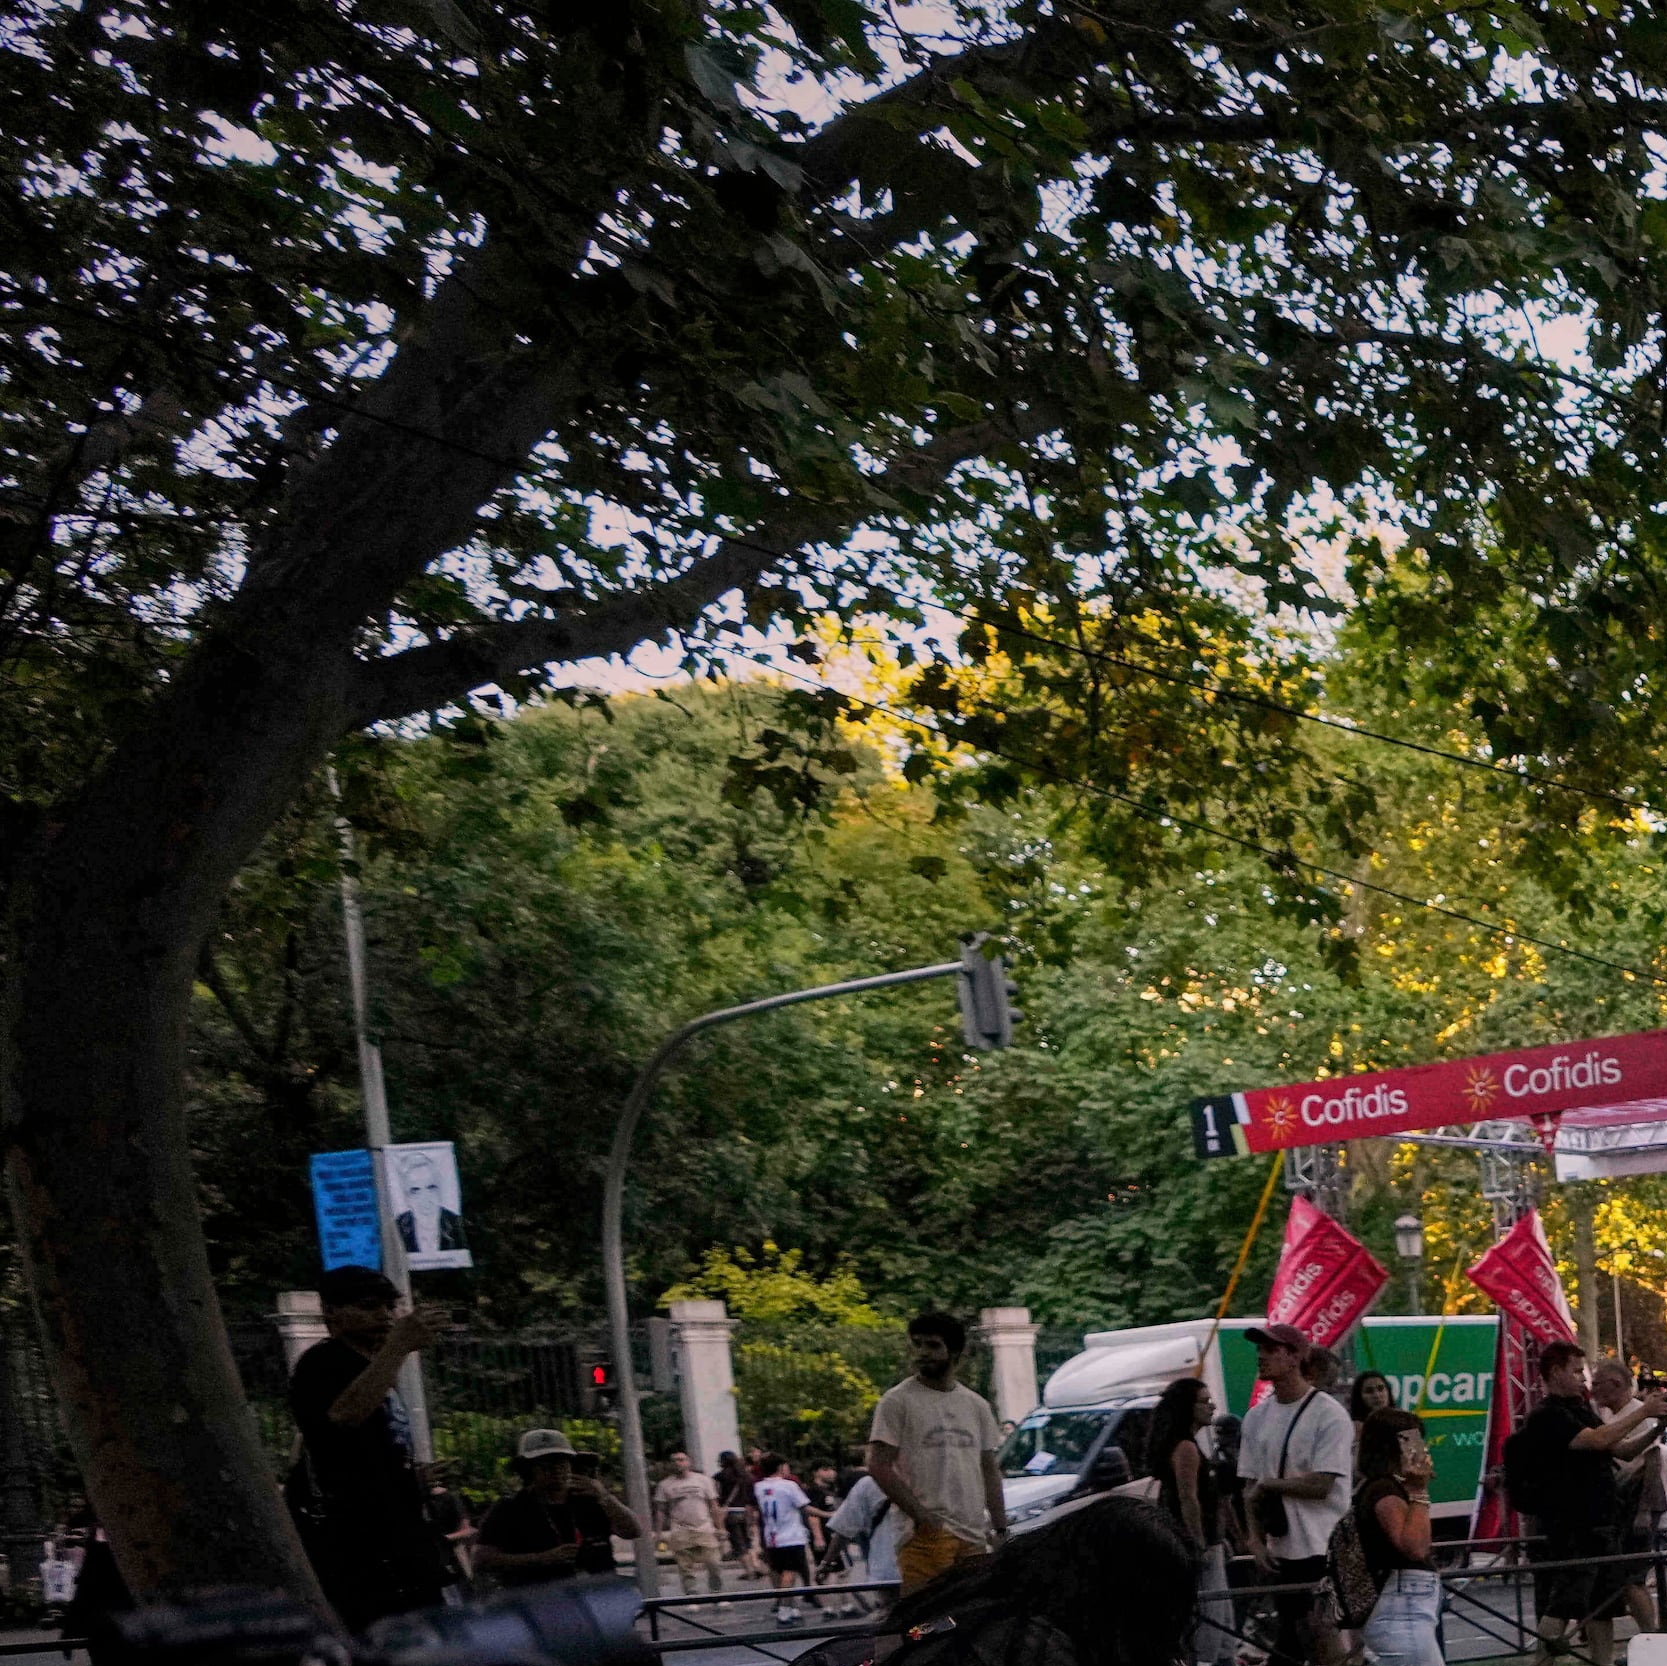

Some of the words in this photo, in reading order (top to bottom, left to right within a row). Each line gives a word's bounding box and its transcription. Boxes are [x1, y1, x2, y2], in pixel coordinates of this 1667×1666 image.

[1503, 1052, 1622, 1098] Cofidis
[1203, 1104, 1219, 1137] 1
[1302, 1084, 1408, 1127] Cofidis
